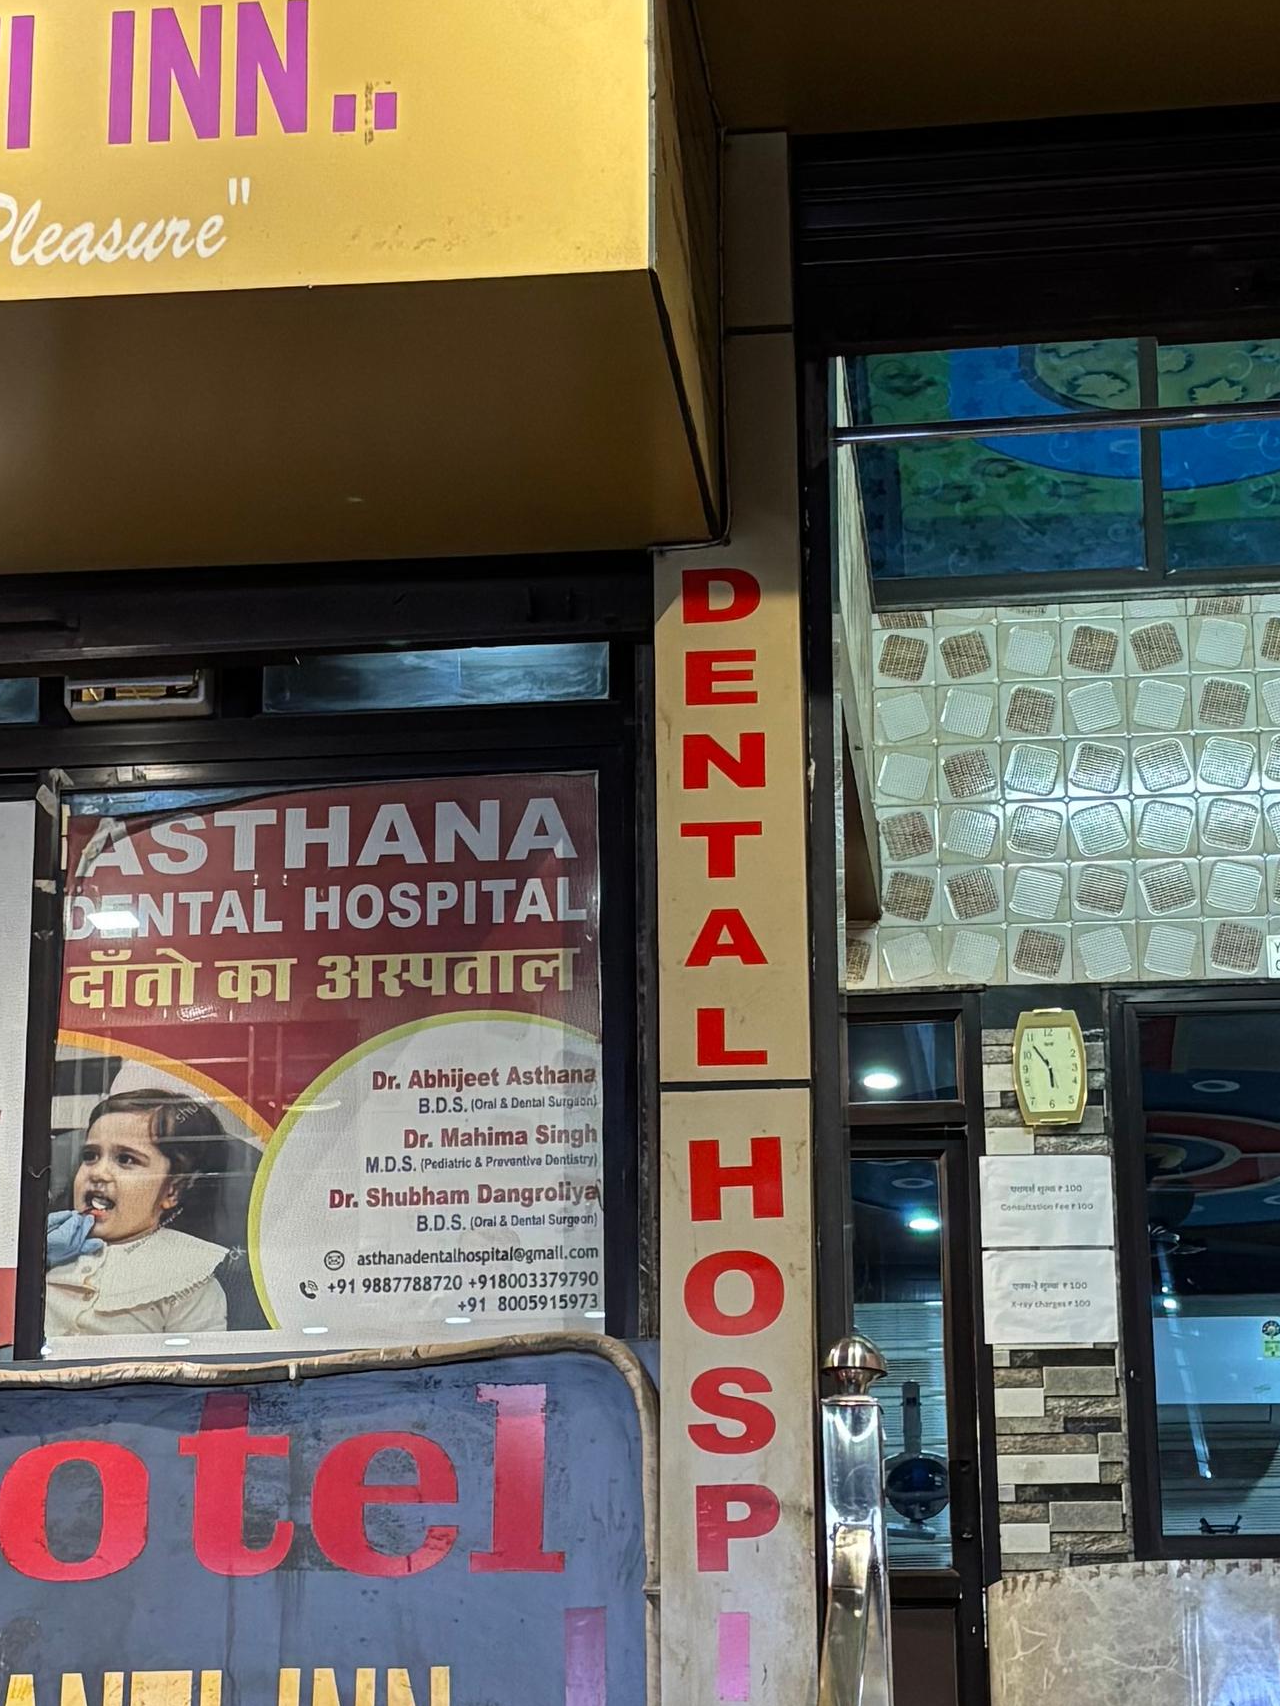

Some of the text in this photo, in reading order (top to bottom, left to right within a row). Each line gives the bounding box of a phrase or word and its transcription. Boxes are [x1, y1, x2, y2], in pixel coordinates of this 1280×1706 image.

[681, 568, 768, 1067] DENTAL
[75, 797, 578, 878] ASTHANA
[305, 877, 587, 932] HOSPITAL
[215, 957, 298, 1003] का
[316, 947, 581, 1001] अस्पताल
[372, 1066, 597, 1092] Dr. Abhijeet Asthana
[418, 1097, 468, 1114] B.D.S.
[403, 1123, 598, 1148] Dr. Mahima Singh
[365, 1156, 417, 1173] M.D.S.
[329, 1181, 598, 1208] Dr. Shubham Dangroliya
[416, 1215, 466, 1232] B.D.S.
[357, 1245, 598, 1267] asthanadentalhospital@gmail.com
[328, 1279, 355, 1294] +91
[362, 1275, 462, 1293] 9887788720
[458, 1293, 598, 1312] +91 8005915973
